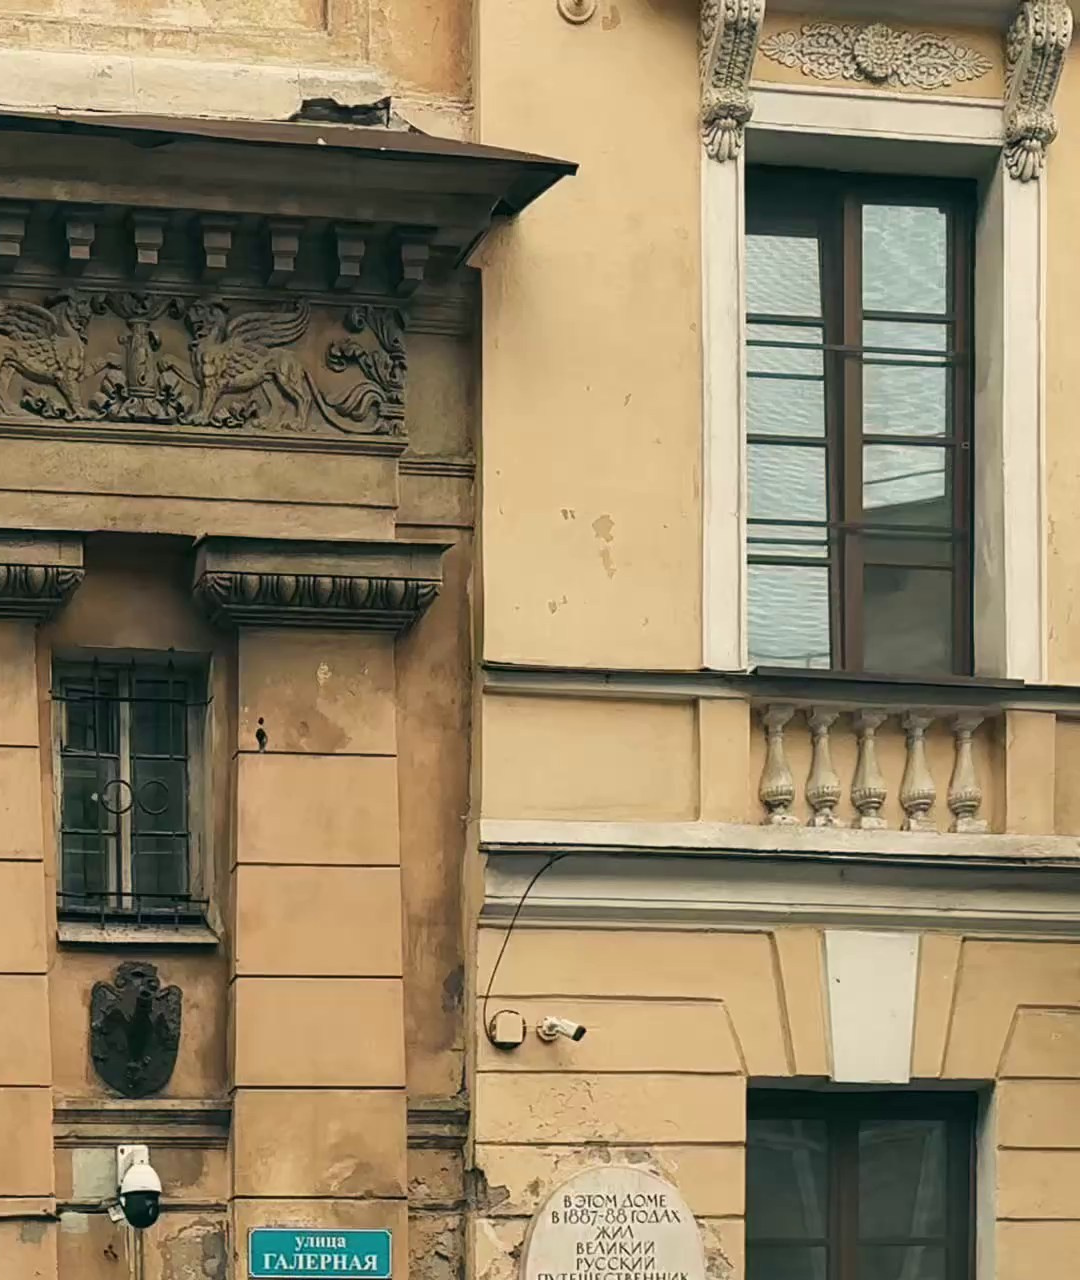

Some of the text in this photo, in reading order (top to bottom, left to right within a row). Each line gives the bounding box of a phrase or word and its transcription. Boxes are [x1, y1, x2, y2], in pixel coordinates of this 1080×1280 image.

[563, 1193, 667, 1208] В ЭТОМ ДОМЕ
[551, 1208, 681, 1226] В 1887-88 ГОДАХ
[594, 1225, 634, 1240] ЖИЛ
[295, 1236, 346, 1251] улица
[576, 1241, 655, 1256] ВЕЛИКИЙ
[263, 1253, 378, 1271] ГАЛЕРНАЯ
[576, 1256, 655, 1272] РУССКИЙ
